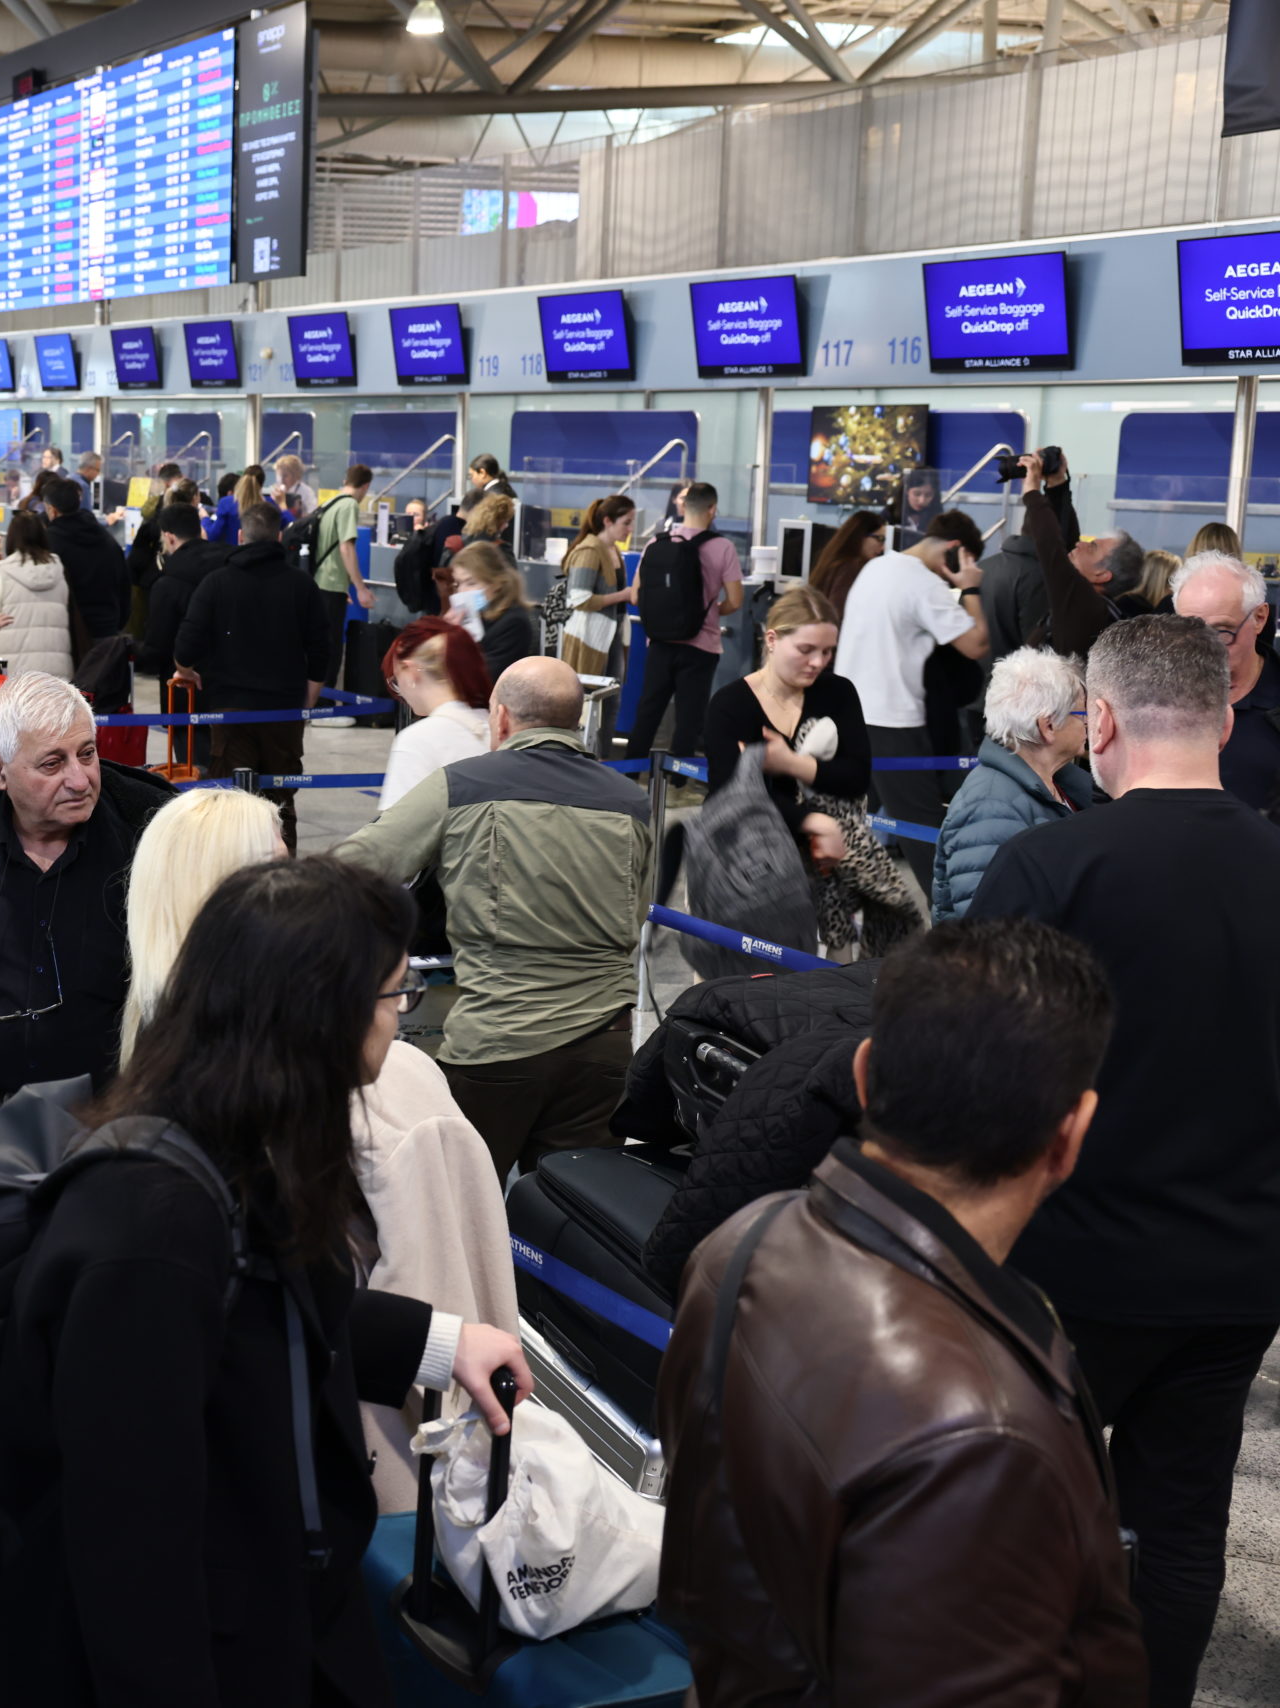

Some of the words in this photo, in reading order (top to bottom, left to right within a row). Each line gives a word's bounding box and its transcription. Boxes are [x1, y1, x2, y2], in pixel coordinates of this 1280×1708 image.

[959, 282, 1014, 298] AEGEAN
[1205, 286, 1275, 302] Self-Service
[717, 300, 759, 313] AEGEAN
[945, 304, 998, 318] Self-Service
[999, 302, 1045, 318] Baggage
[560, 312, 594, 324] AEGEAN
[961, 321, 1014, 334] QuickDrop
[1015, 319, 1029, 332] off
[822, 339, 853, 367] 117
[888, 336, 921, 365] 116
[1228, 349, 1253, 359] STAR
[479, 355, 499, 377] 119
[521, 353, 542, 376] 118
[965, 359, 983, 368] STAR
[984, 358, 1021, 368] ALLIANCE
[199, 713, 224, 721] ATHENS
[752, 940, 782, 956] ATHENS
